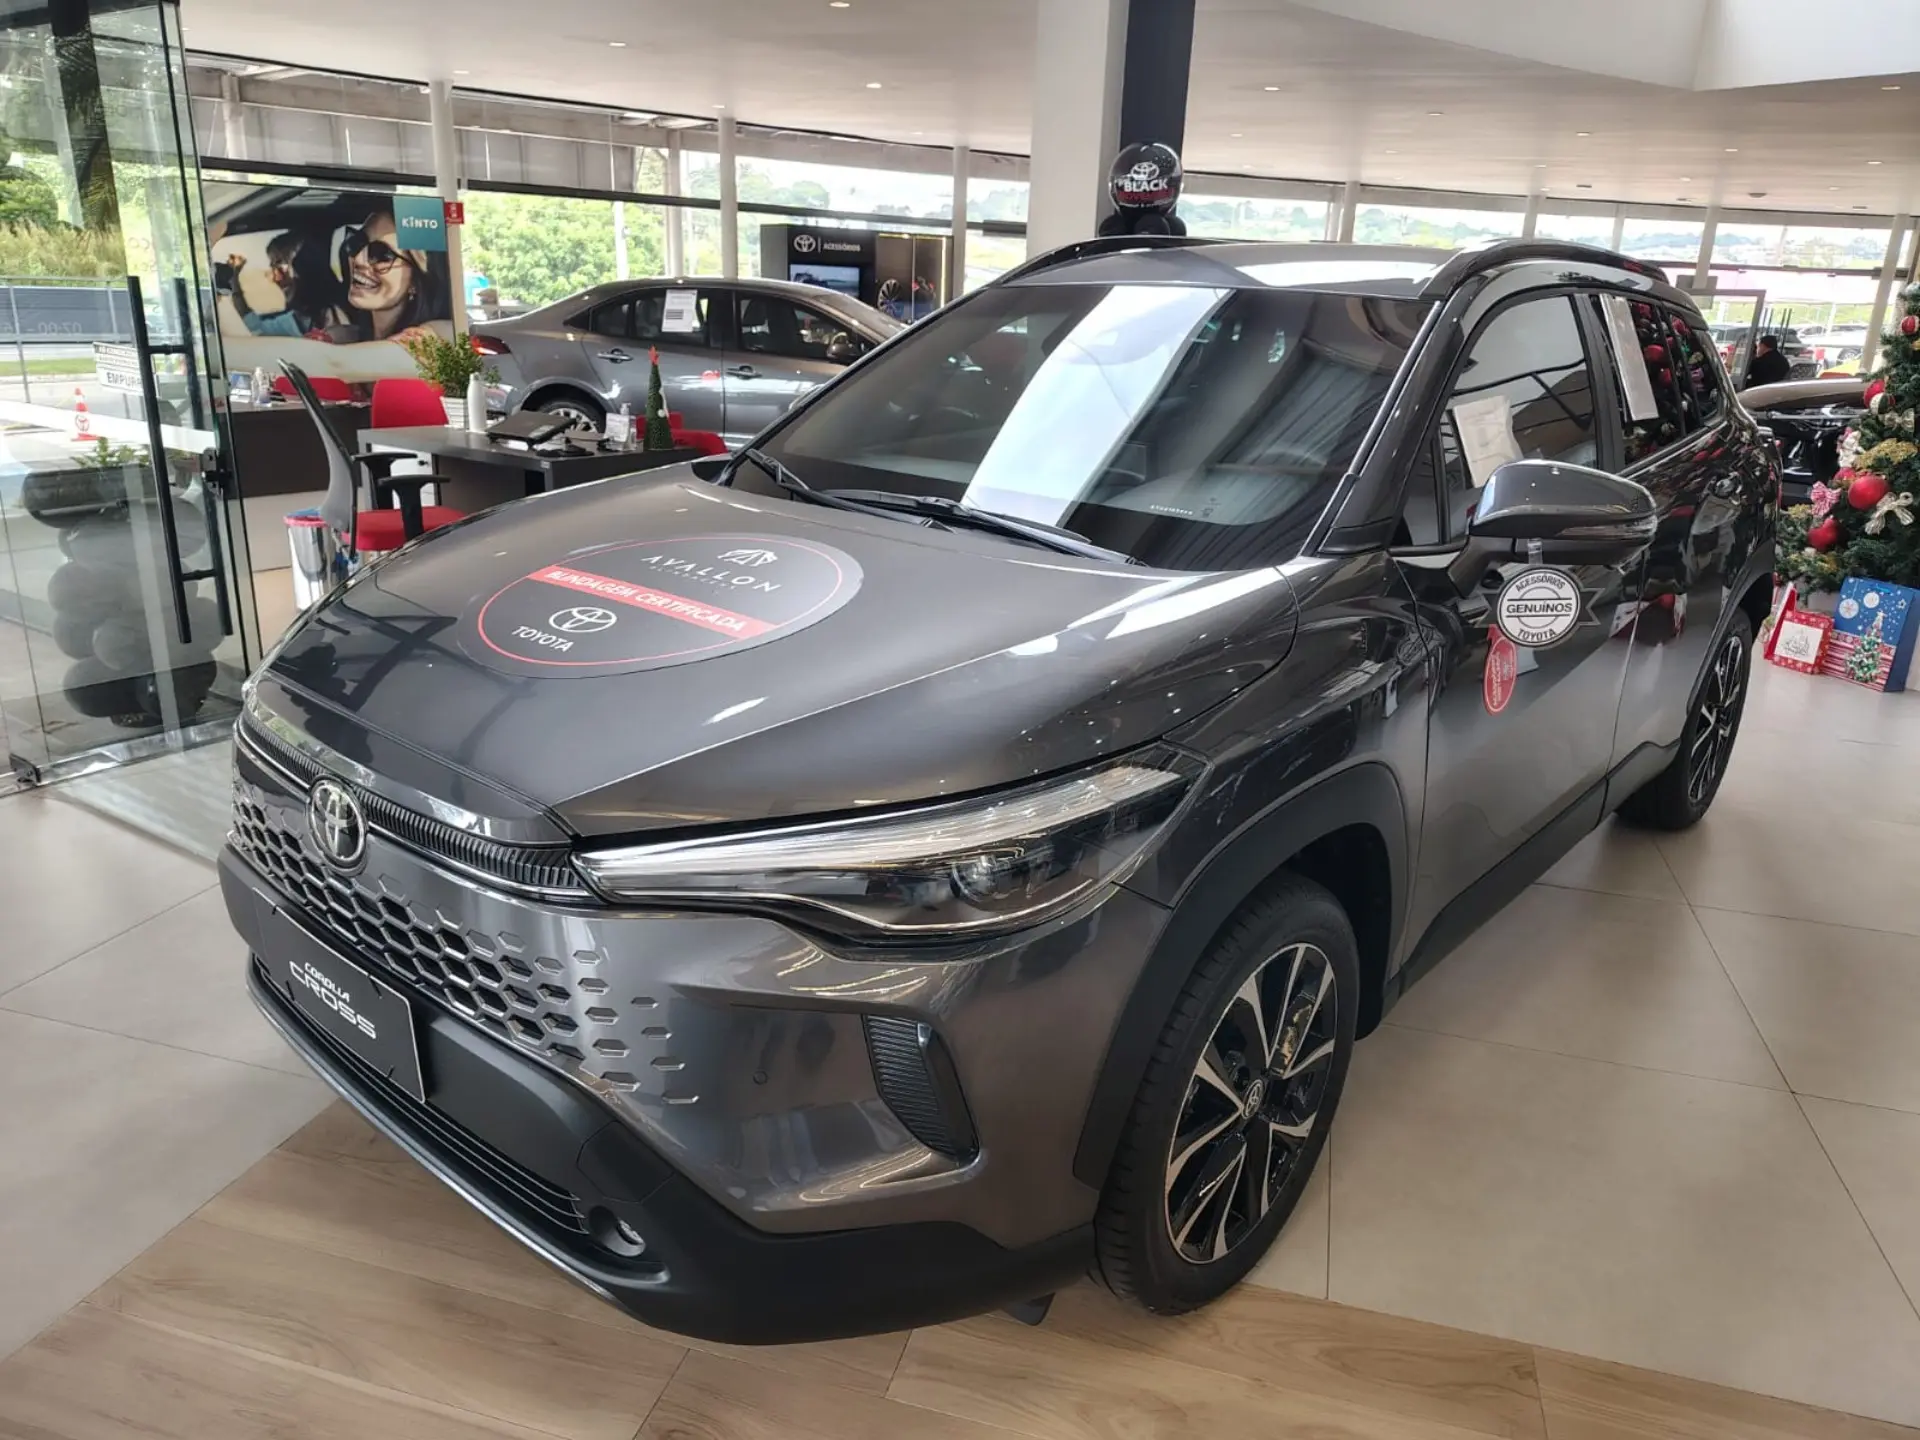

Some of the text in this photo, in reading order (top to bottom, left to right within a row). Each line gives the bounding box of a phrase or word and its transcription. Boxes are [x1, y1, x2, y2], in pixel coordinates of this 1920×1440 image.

[1124, 178, 1168, 193] BLACK
[640, 555, 782, 593] AVALLON
[1515, 573, 1566, 592] ACESSÓRIOS
[544, 570, 637, 598] BLINDAGEM
[635, 592, 747, 632] CERTIFICADA
[1506, 600, 1573, 614] GENUÍNOS
[511, 625, 575, 652] TOYOTA
[1517, 628, 1557, 642] TOYOTA
[304, 962, 350, 1003] COROLLA
[289, 960, 377, 1039] CROSS
